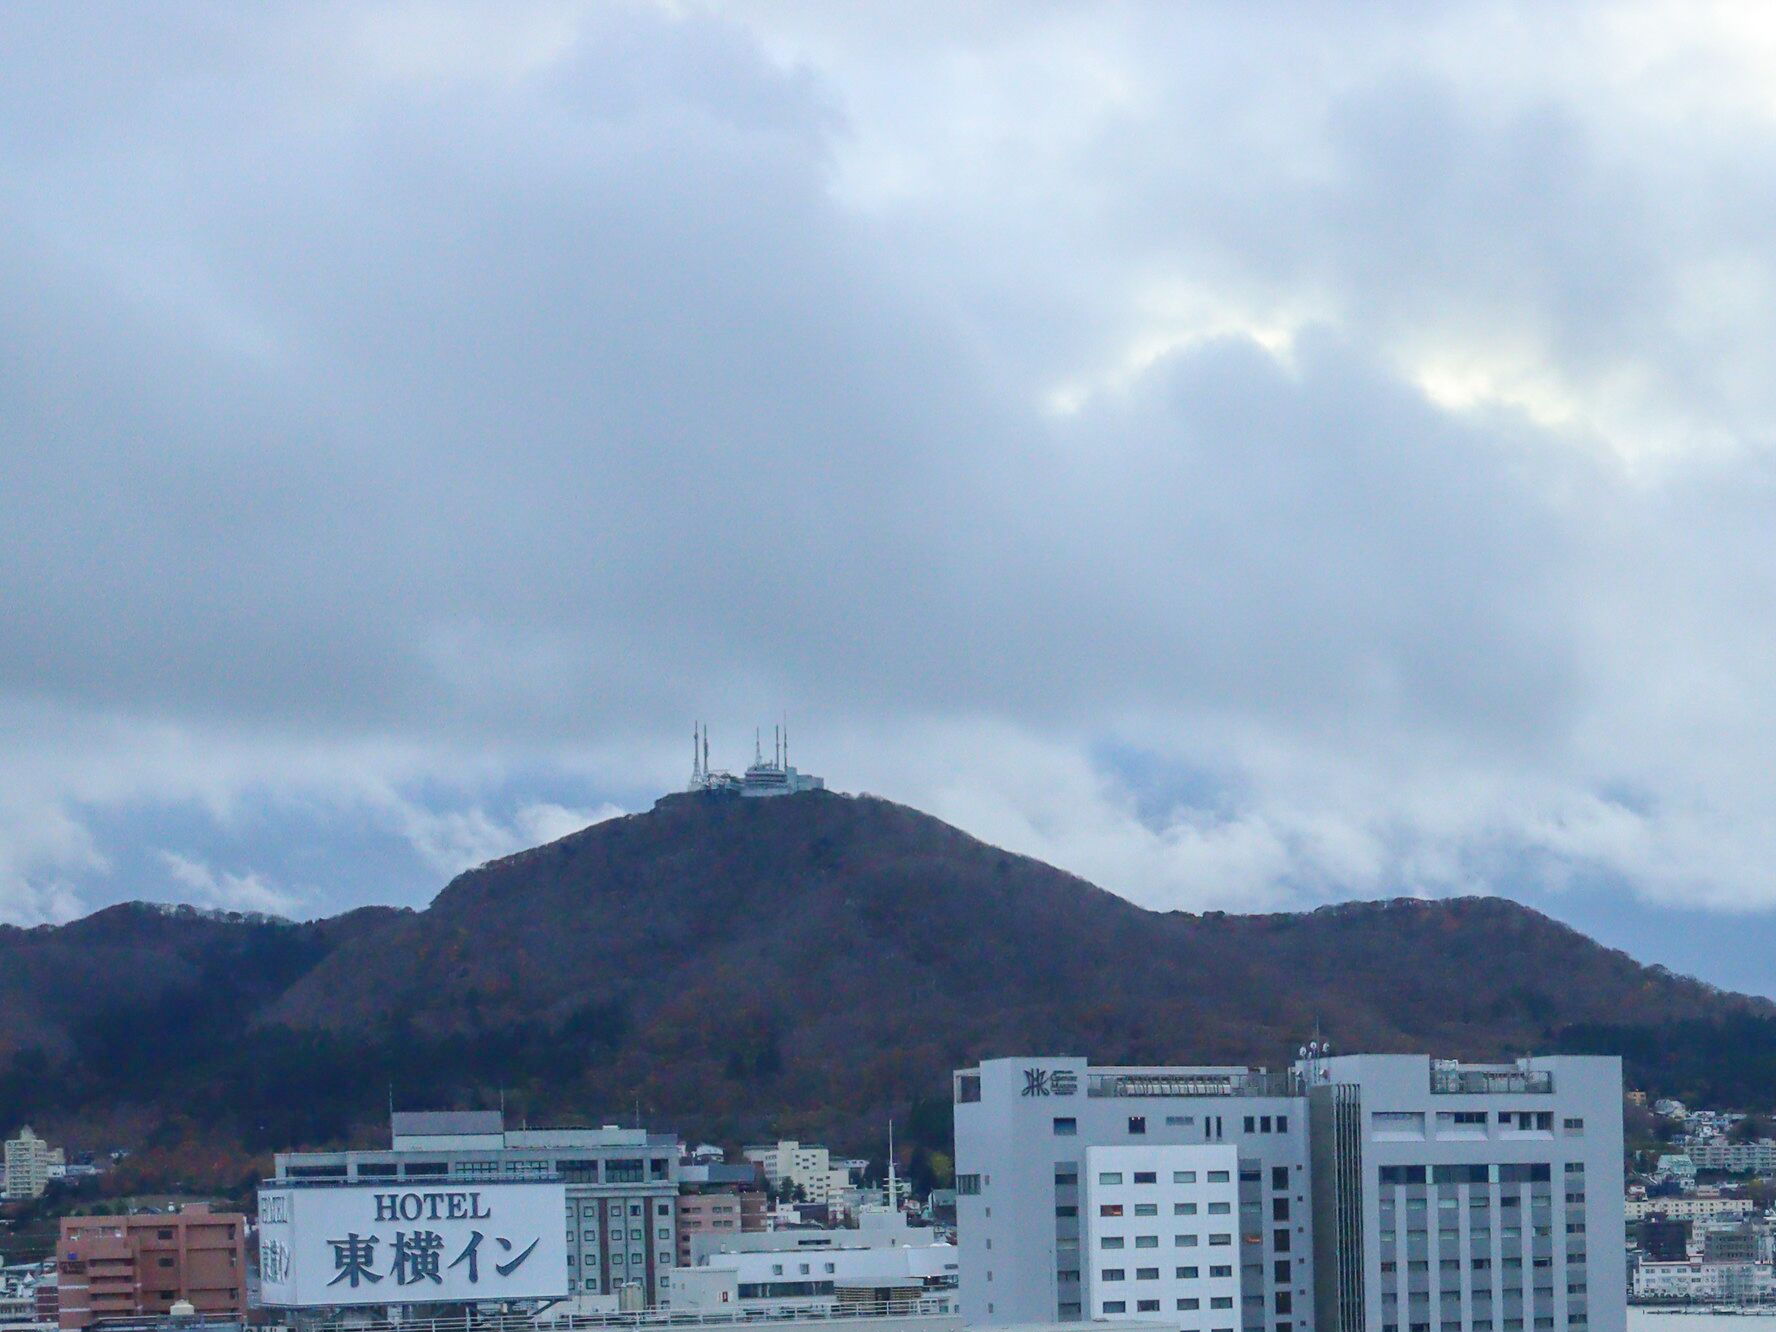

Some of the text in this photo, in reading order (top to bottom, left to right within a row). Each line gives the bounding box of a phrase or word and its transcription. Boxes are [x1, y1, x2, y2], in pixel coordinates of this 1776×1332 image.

[374, 1192, 491, 1222] HOTEL
[326, 1230, 540, 1288] 東横イン
